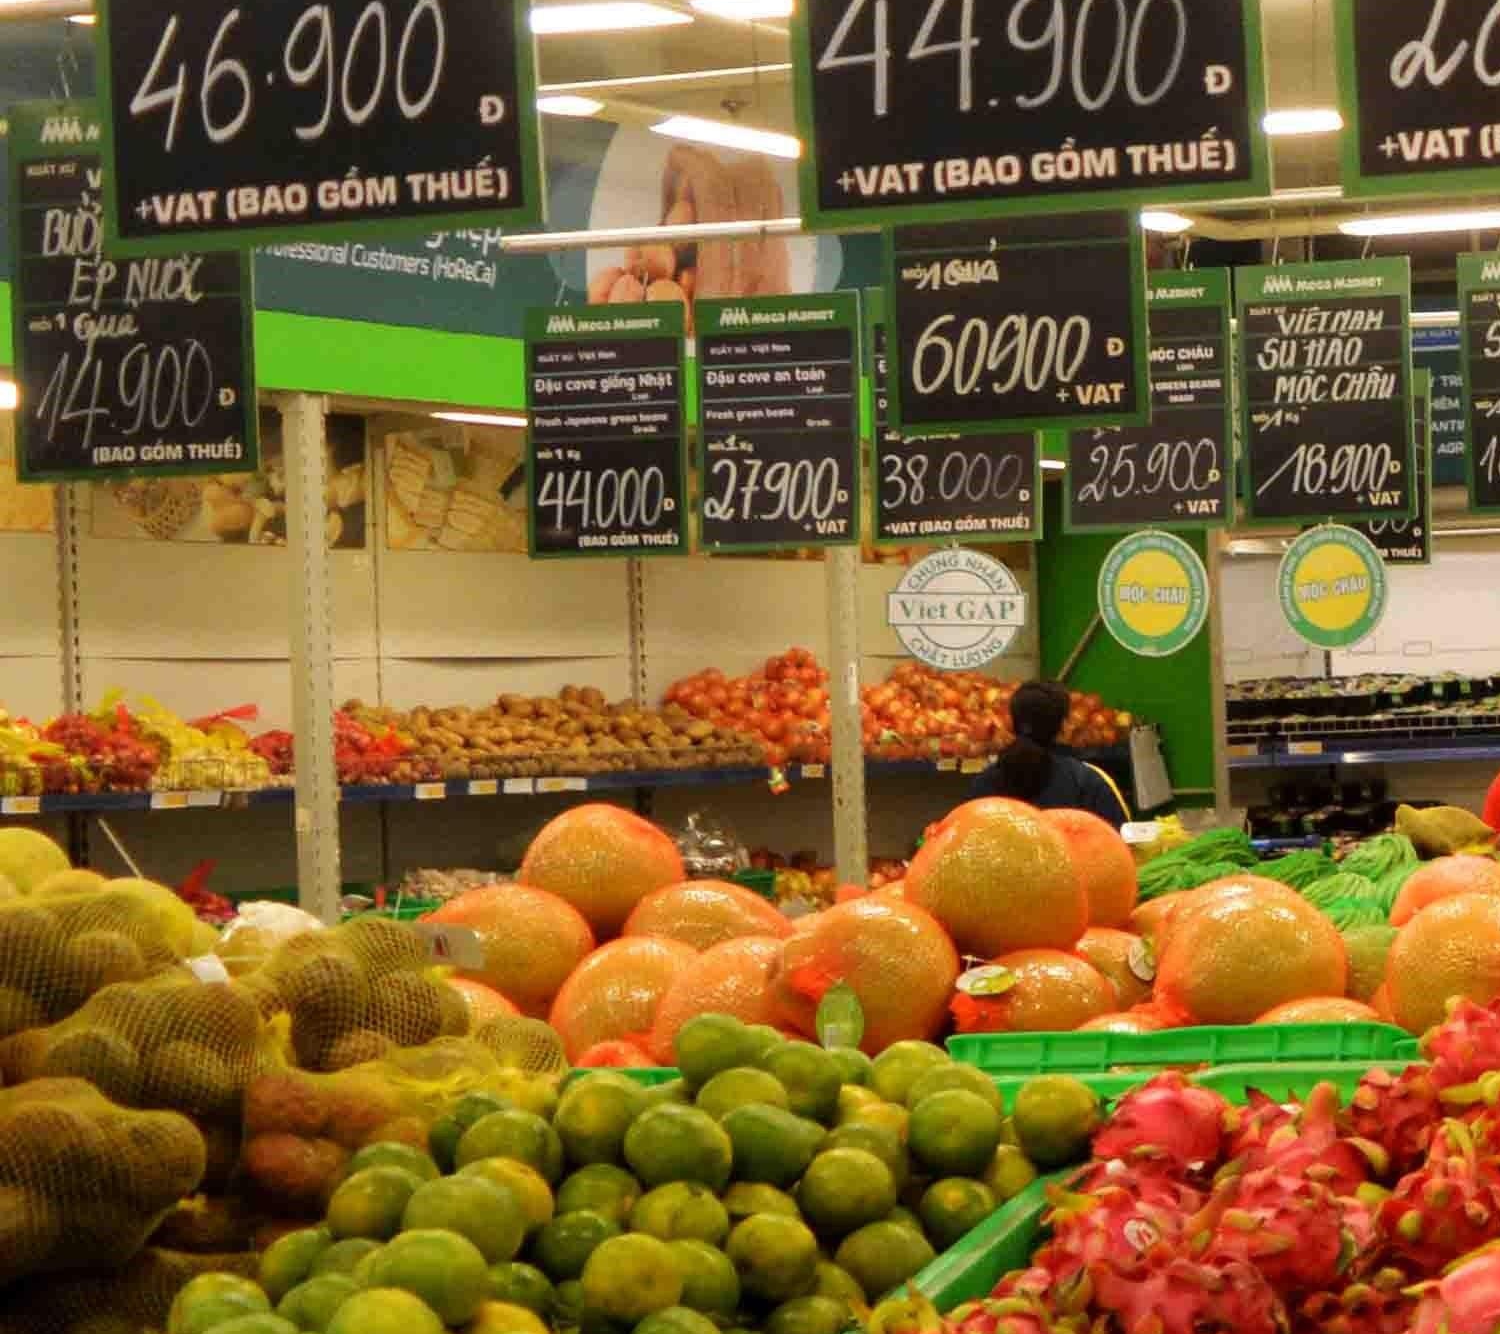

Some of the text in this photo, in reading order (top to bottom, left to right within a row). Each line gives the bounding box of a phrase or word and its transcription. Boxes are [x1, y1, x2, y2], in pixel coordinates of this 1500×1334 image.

[227, 180, 308, 216] (BAO
[406, 156, 508, 202] THUẾ)
[351, 246, 429, 275] Customers
[911, 313, 1091, 395] 60.900
[36, 338, 213, 449] 14.900
[538, 466, 663, 529] 44.000
[704, 457, 838, 523] 27.900
[882, 451, 1023, 510] 38.000
